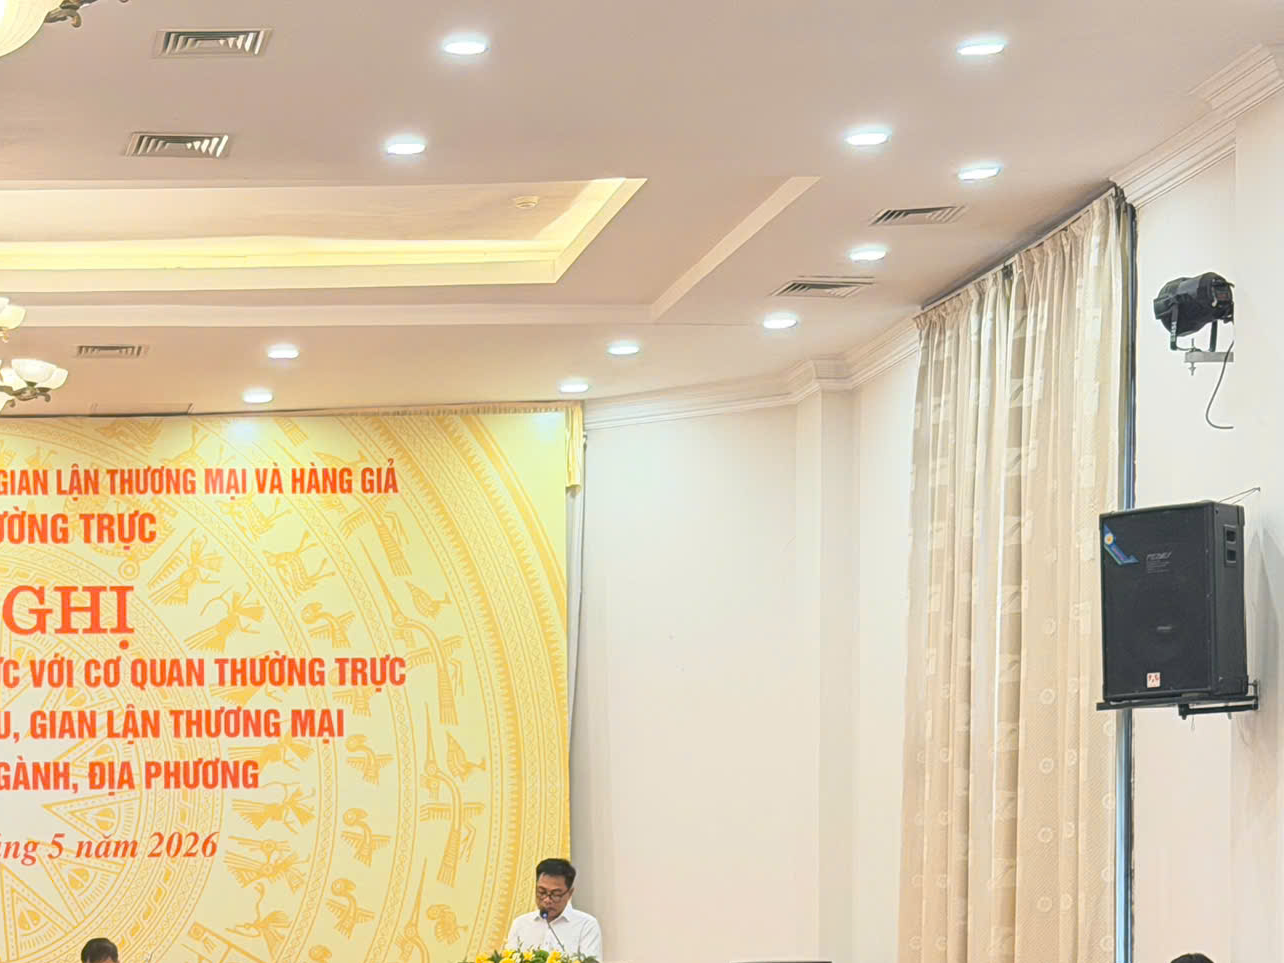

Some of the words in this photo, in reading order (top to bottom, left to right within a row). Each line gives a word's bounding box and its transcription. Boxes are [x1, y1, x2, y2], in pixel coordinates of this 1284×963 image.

[56, 463, 100, 502] LẬN
[106, 465, 197, 496] THƯƠNG
[204, 468, 247, 500] MẠI
[255, 462, 284, 494] VÀ
[291, 463, 353, 495] HÀNG
[361, 458, 399, 494] GIẢ
[79, 510, 157, 551] TRỰC
[29, 653, 74, 689] VỚI
[83, 655, 122, 689] CƠ
[130, 658, 205, 691] QUAN
[214, 651, 326, 688] THƯỜNG
[335, 655, 406, 693] TRỰC
[29, 710, 97, 740] GIAN
[107, 703, 161, 745] LẬN
[169, 706, 281, 739] THƯƠNG
[291, 708, 344, 745] MẠI
[87, 760, 136, 797] ĐỊA
[144, 757, 260, 790] PHƯƠNG
[48, 833, 65, 860] 5
[75, 836, 139, 859] năm
[147, 831, 218, 859] 2026
